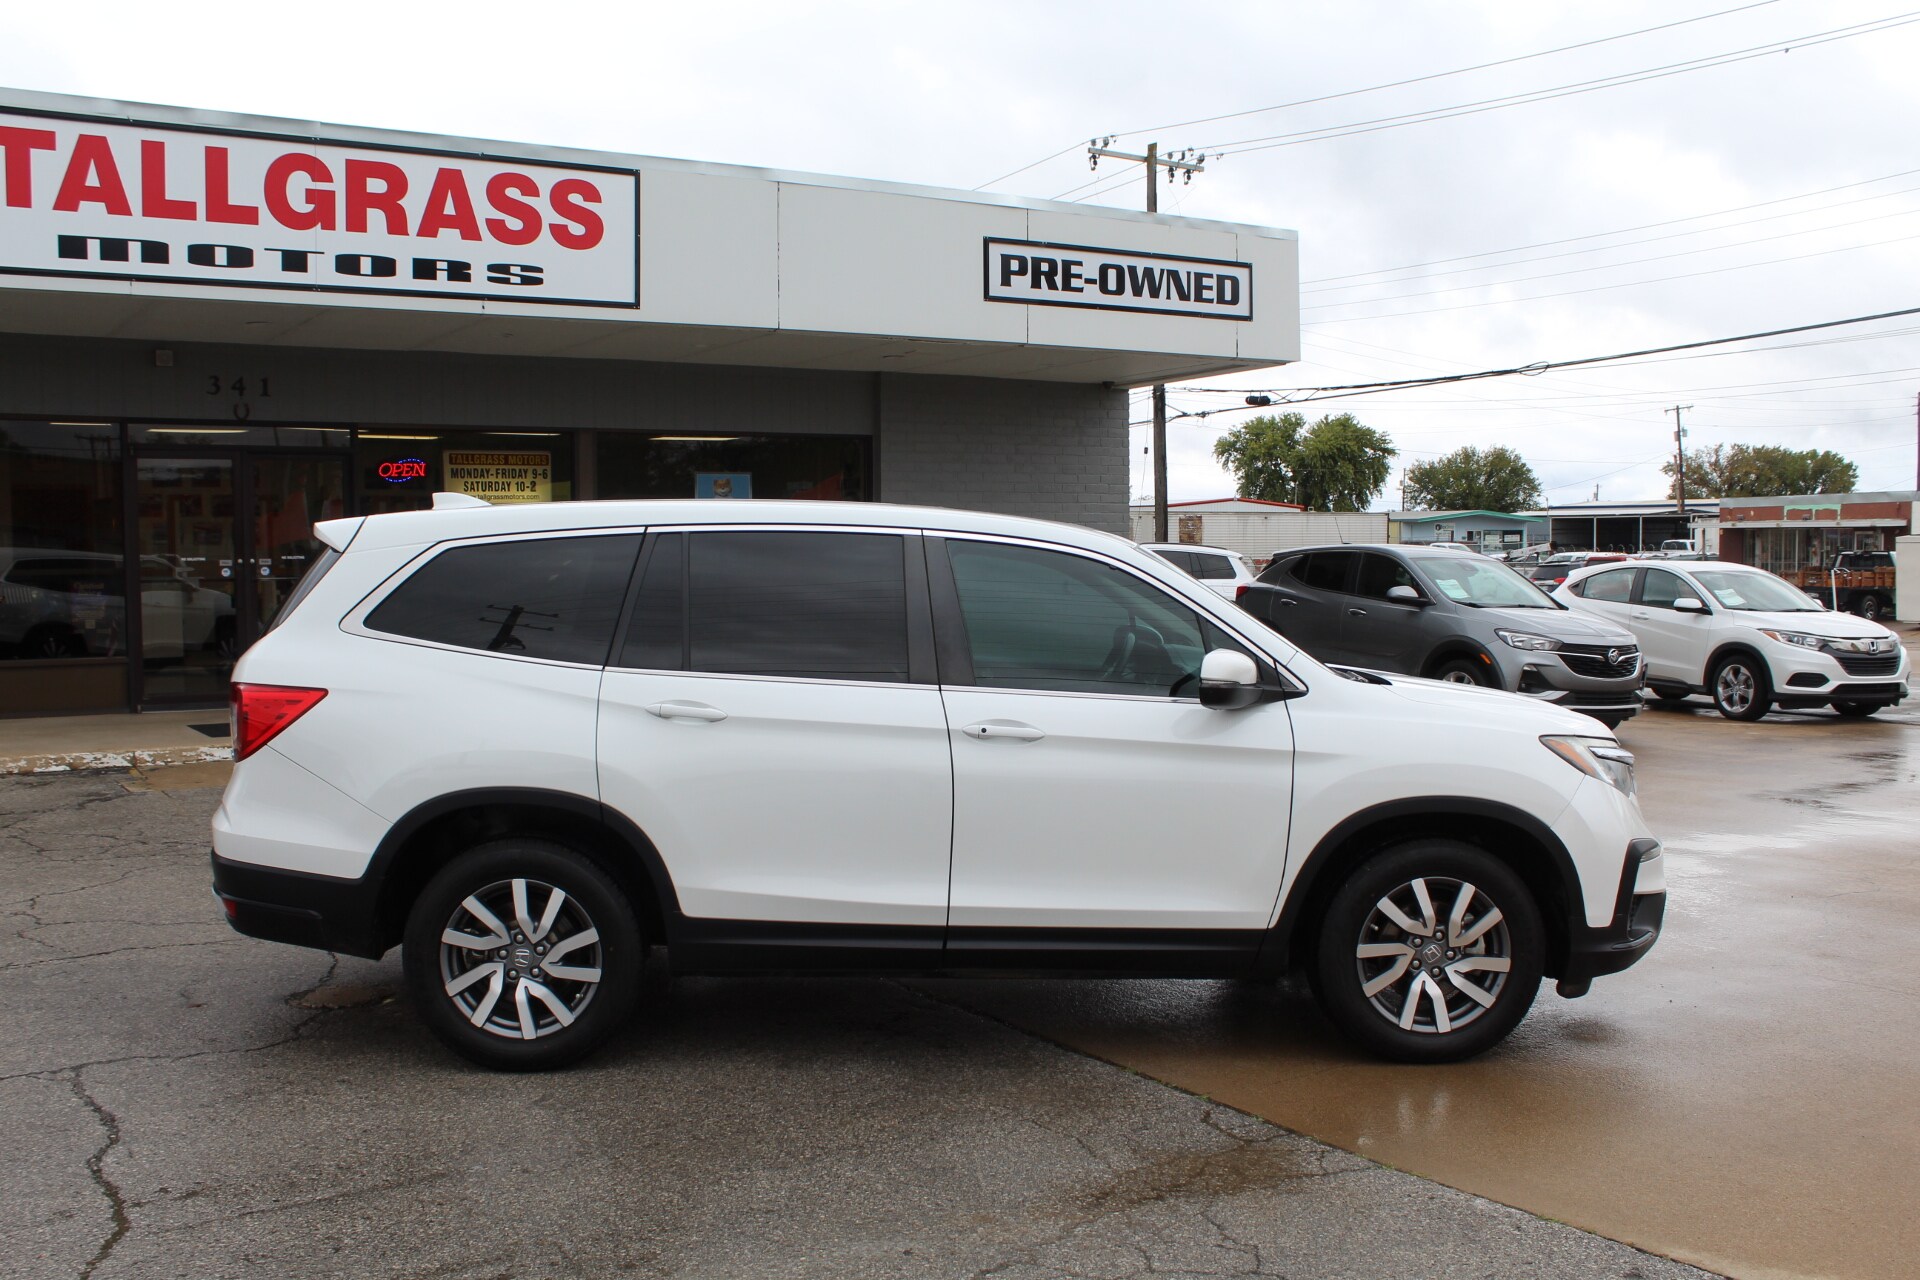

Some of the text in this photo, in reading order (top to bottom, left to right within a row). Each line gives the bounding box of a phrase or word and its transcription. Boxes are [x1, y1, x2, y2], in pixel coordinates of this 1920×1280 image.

[0, 125, 605, 250] TALLGRASS
[1000, 253, 1240, 306] PRE-OWNED
[451, 454, 548, 465] TALLGRASS MOTORS
[378, 462, 427, 478] OPEN
[532, 469, 549, 480] 9-6
[463, 480, 537, 493] SATURDAY 10-2
